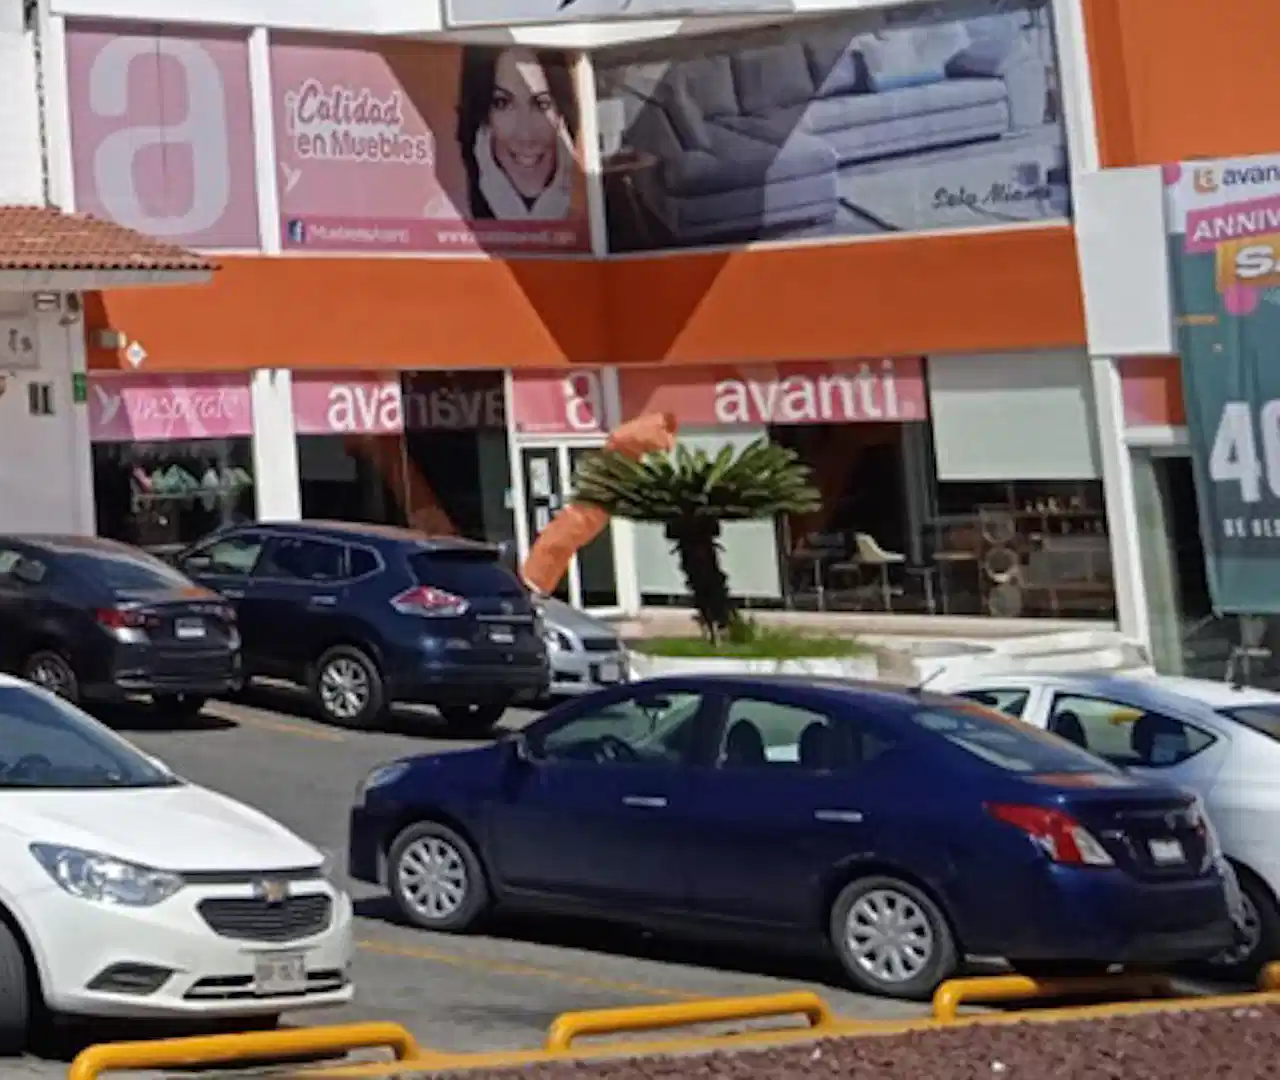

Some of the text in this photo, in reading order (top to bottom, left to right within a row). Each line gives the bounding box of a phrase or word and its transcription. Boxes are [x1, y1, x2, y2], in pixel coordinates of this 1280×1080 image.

[297, 132, 328, 156] en
[1235, 244, 1280, 279] S
[713, 361, 898, 423] avanti
